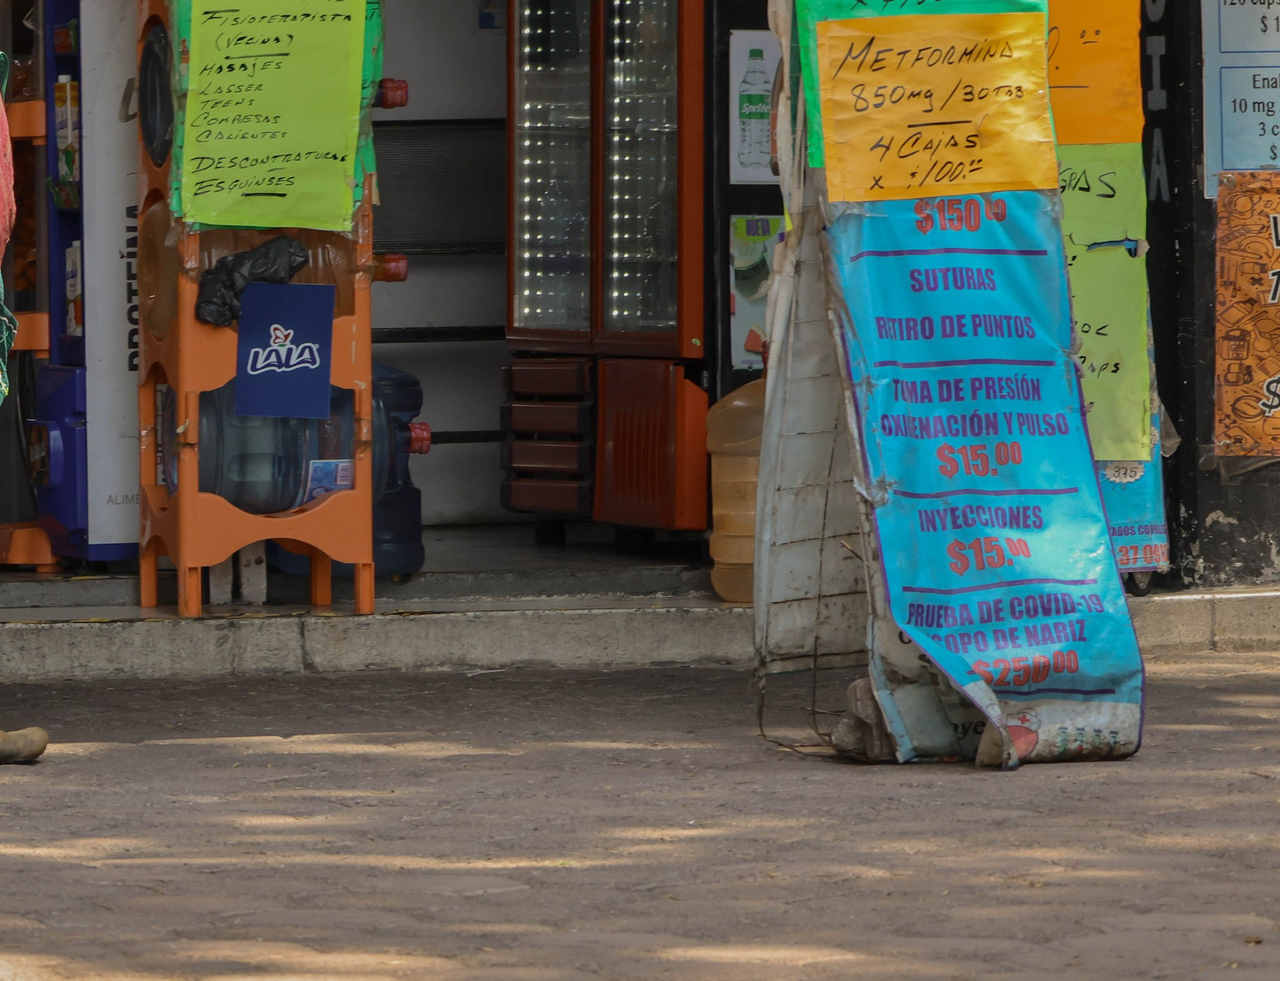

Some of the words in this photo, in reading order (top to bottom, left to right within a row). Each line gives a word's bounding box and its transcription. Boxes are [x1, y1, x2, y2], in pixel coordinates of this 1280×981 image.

[832, 36, 1014, 80] METFORMINA
[740, 101, 771, 116] Sprite
[1230, 98, 1248, 113] 10
[1252, 102, 1275, 117] mg
[909, 267, 996, 293] SUTURAS
[940, 314, 967, 338] DE
[972, 314, 1036, 339] PUNTOS
[247, 343, 320, 375] LALA
[937, 377, 967, 402] DE
[1004, 412, 1016, 435] Y
[1016, 412, 1069, 436] PULSO
[917, 503, 1044, 533] INYECCIONES
[907, 602, 974, 629] PRUEBA
[977, 600, 1005, 624] DE
[1008, 592, 1105, 620] COVID-19
[992, 626, 1021, 651] DE
[1024, 619, 1087, 647] NARIZ
